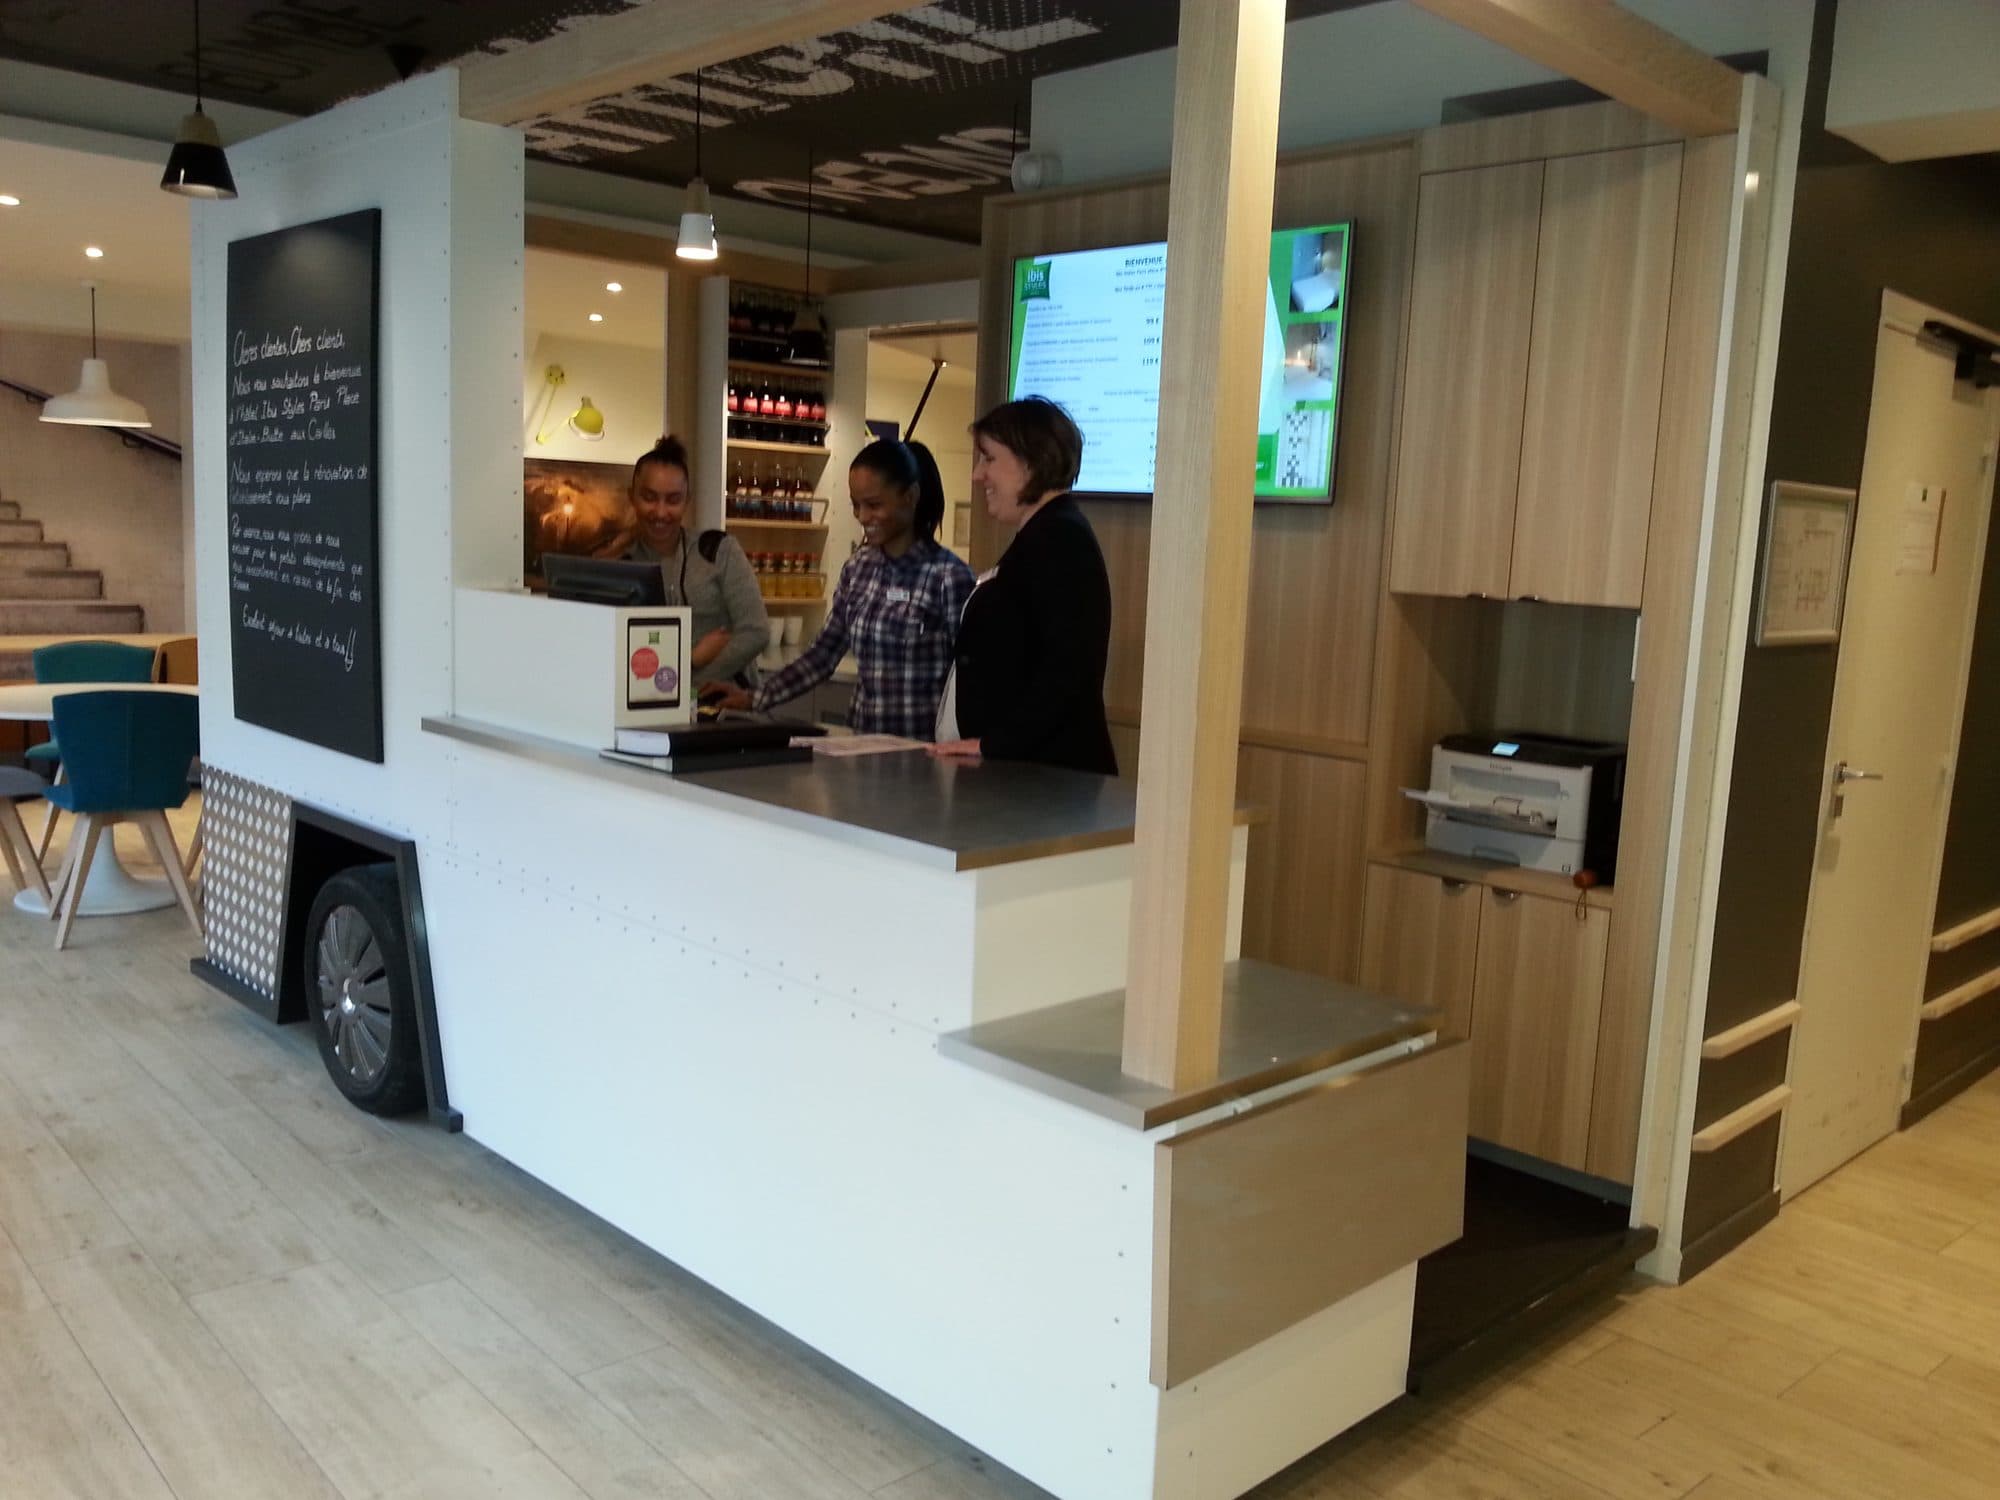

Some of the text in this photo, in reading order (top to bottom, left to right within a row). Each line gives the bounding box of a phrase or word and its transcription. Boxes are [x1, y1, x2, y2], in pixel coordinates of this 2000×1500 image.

[1124, 256, 1163, 267] BIENVENUE
[1027, 267, 1044, 282] ibis
[232, 371, 250, 398] Nous
[309, 390, 331, 412] Paris
